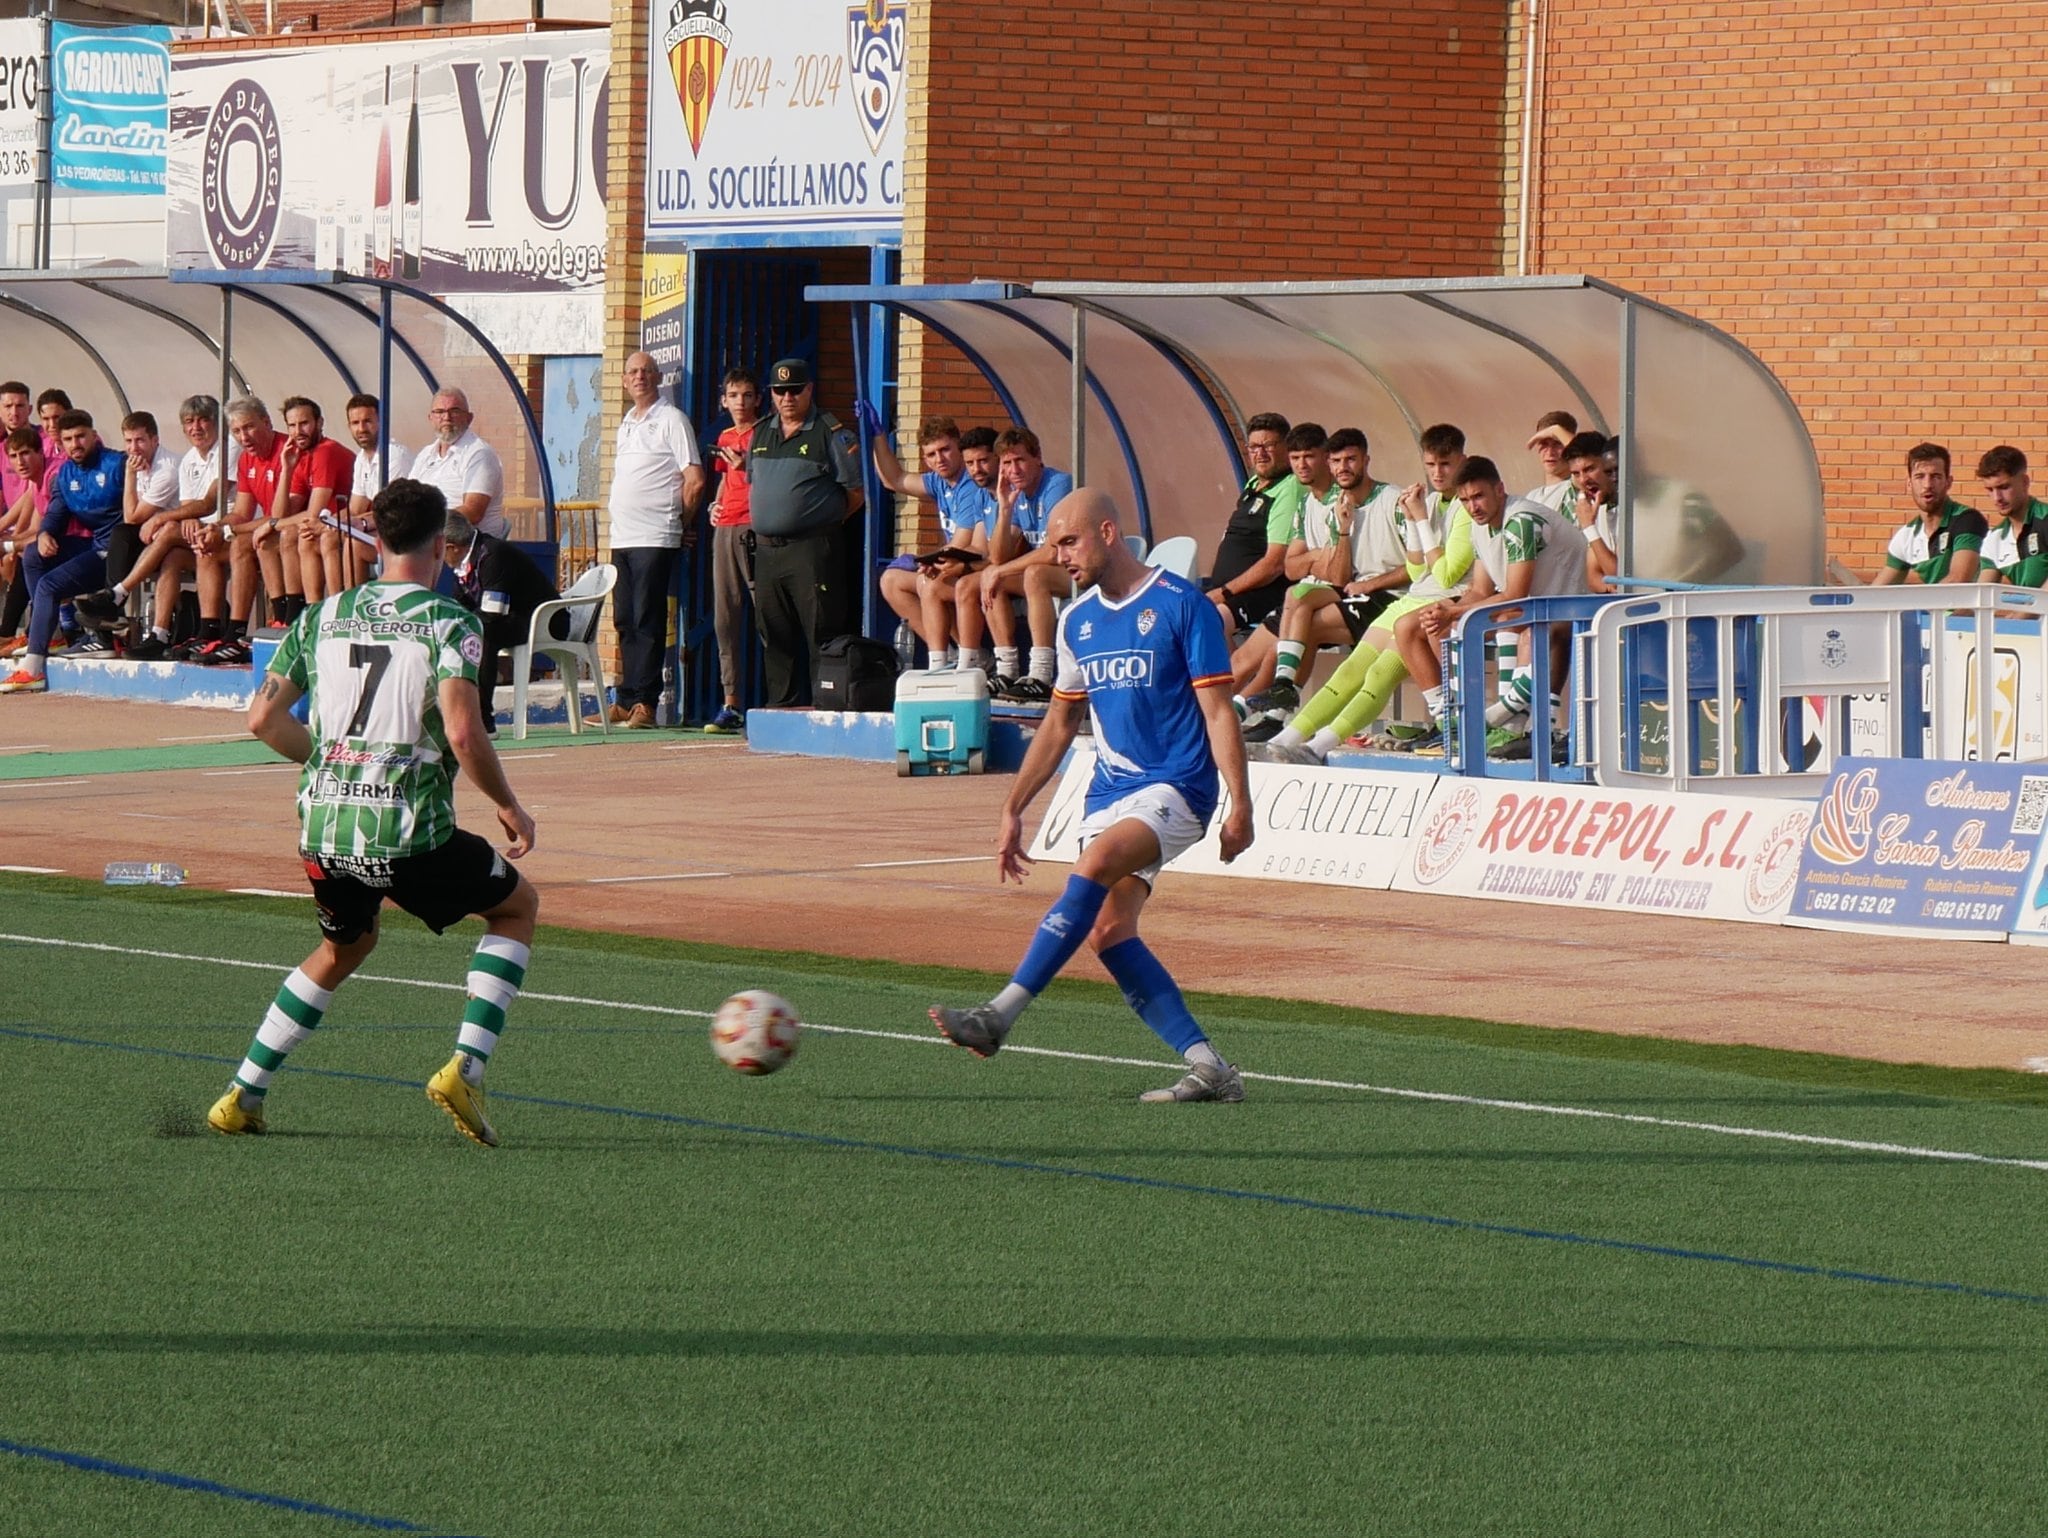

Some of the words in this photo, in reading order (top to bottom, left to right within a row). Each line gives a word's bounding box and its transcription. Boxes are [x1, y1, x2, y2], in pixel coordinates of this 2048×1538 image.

[728, 54, 772, 109] 1924
[789, 54, 843, 108] 2024
[14, 150, 30, 175] 36
[206, 105, 232, 213] CRISTO
[250, 91, 266, 124] LA
[265, 128, 279, 209] VEGA
[56, 165, 73, 179] LAS
[657, 169, 696, 210] U.D.
[708, 156, 868, 209] SOCUÉLLAMOS
[881, 161, 905, 203] C.
[216, 230, 266, 262] BODEGAS
[646, 319, 680, 345] DISEÑO
[370, 621, 433, 637] CEROTE
[1080, 655, 1147, 687] YUGO
[347, 643, 392, 737] 7
[340, 781, 404, 800] BERMA
[1267, 778, 1423, 839] CAUTELA
[1478, 793, 1674, 873] ROBLEPOL,
[1683, 807, 1754, 870] S.L.
[1874, 813, 1941, 868] García
[1263, 855, 1367, 880] BODEGAS
[1805, 869, 1839, 884] Antonio
[1477, 863, 1584, 900] FABRICADOS
[1584, 872, 1617, 902] EN
[1616, 875, 1713, 911] POLIESTER
[1814, 891, 1839, 911] 692
[1840, 894, 1857, 912] 61
[1858, 895, 1877, 913] 52
[1877, 897, 1896, 914] 02
[1933, 901, 1956, 918] 692
[1956, 902, 1972, 919] 61
[1971, 902, 1987, 920] 52
[1986, 904, 2004, 921] 01
